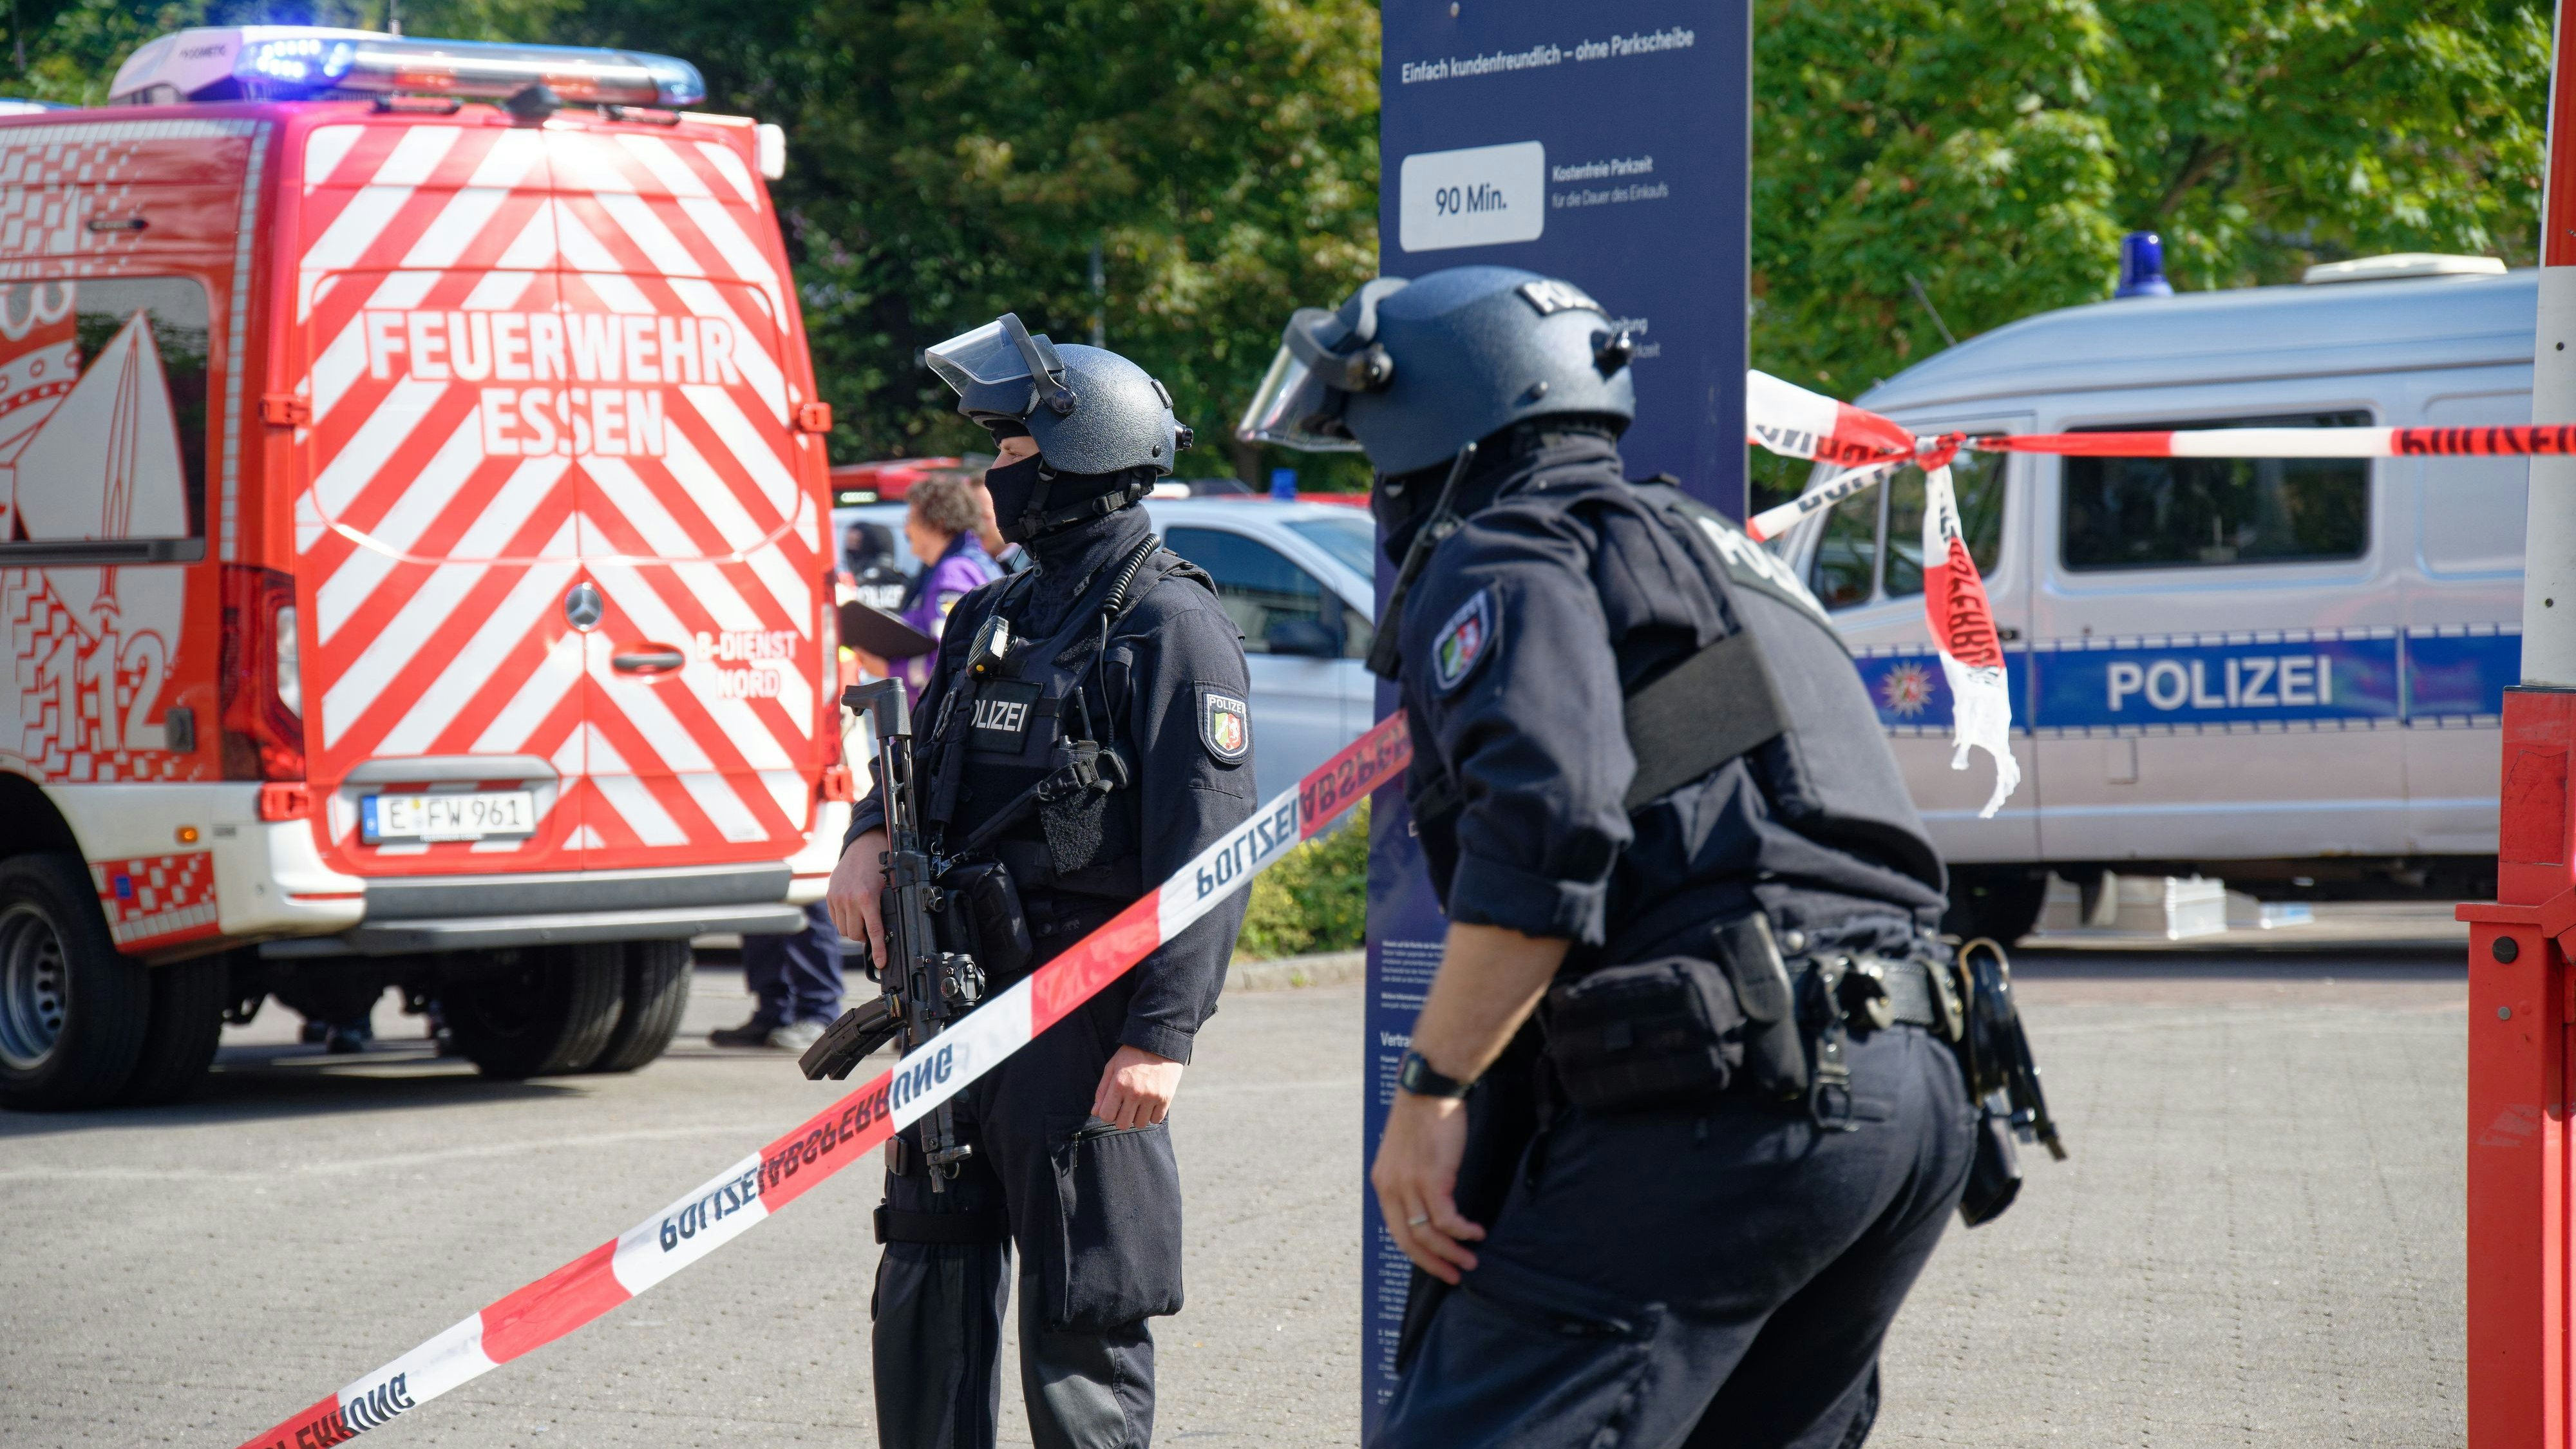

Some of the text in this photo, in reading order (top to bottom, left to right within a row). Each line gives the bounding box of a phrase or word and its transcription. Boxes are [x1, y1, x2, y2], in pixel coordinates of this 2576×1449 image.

[1402, 58, 1448, 84] Einfach
[1451, 43, 1561, 77] kundenfreundlich
[1576, 39, 1609, 61] ohne
[1611, 26, 1695, 56] Parkscheibe
[1553, 154, 1653, 182] Kostenfreie Parkzeit
[1436, 182, 1507, 216] 90 Min.
[1566, 191, 1582, 207] die
[1582, 189, 1610, 205] Dauer
[1611, 186, 1628, 203] des
[365, 311, 742, 384] FEUERWEHR
[481, 388, 666, 456] ESSEN
[696, 630, 797, 661] B-DIENST
[43, 629, 167, 751] 112
[717, 669, 780, 699] NORD
[2108, 656, 2332, 710] POLIZEI
[971, 699, 1028, 732] LIZEI
[1209, 697, 1244, 714] POLIZEI
[389, 799, 520, 829] E FW 961
[1380, 1032, 1414, 1048] Vertra
